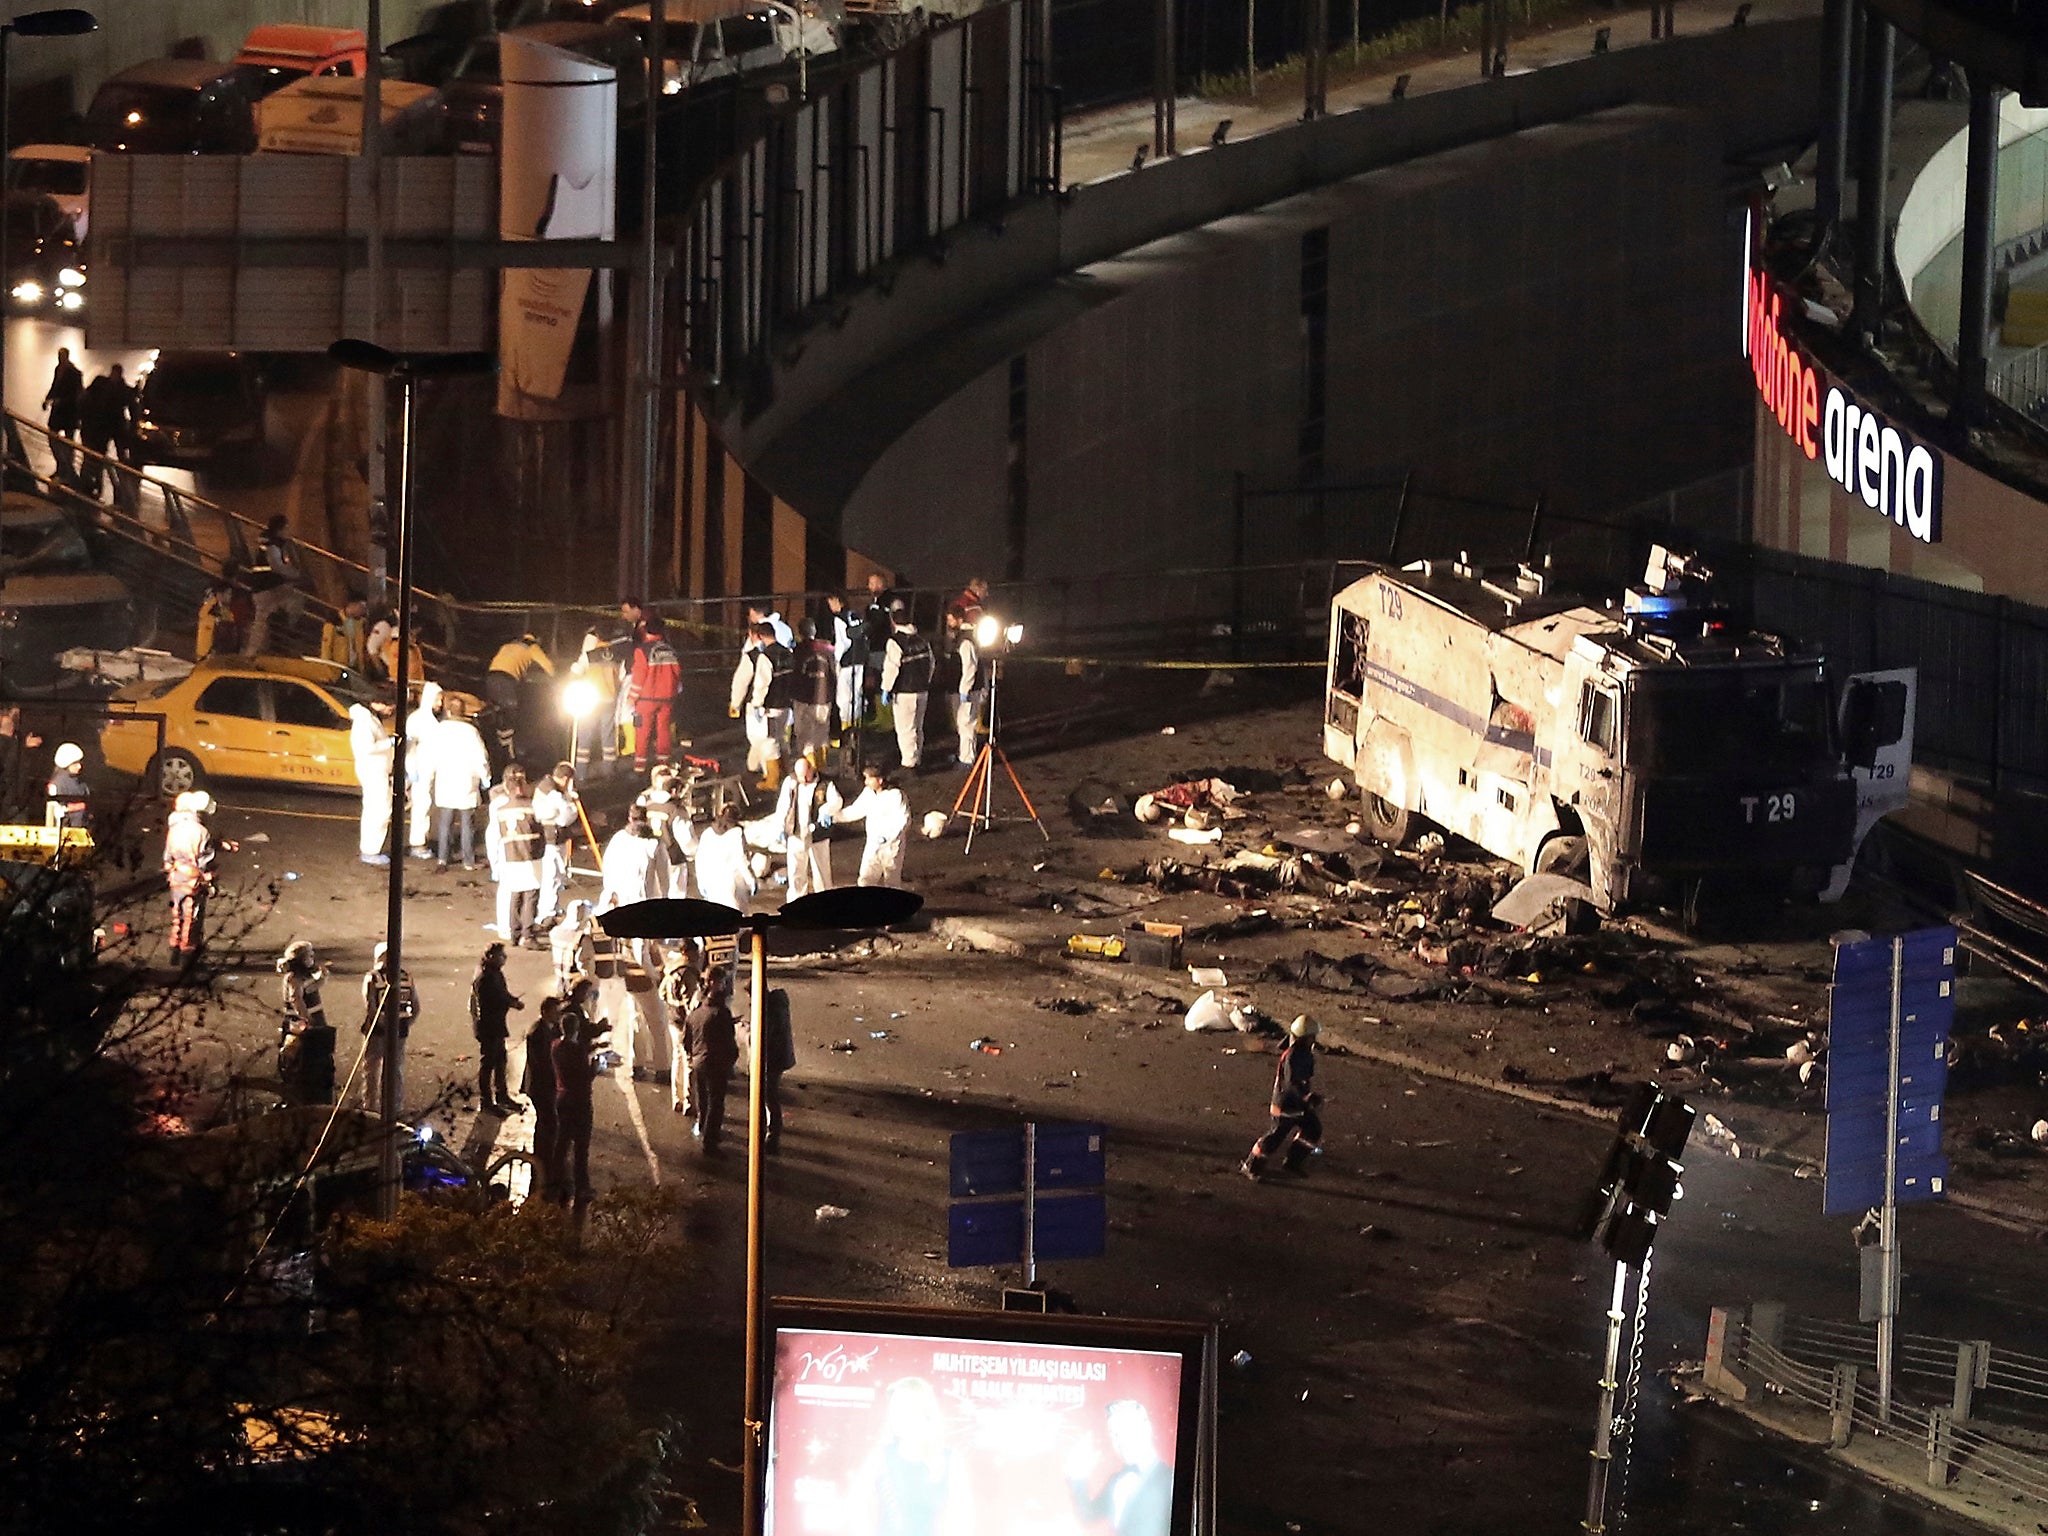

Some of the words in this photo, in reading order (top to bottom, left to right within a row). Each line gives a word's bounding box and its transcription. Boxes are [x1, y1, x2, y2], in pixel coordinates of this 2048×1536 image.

[1823, 386, 1935, 544] arena
[1579, 762, 1597, 783] T29
[1740, 796, 1760, 824] T
[1767, 793, 1796, 823] 29
[1060, 1360, 1107, 1381] GALASI
